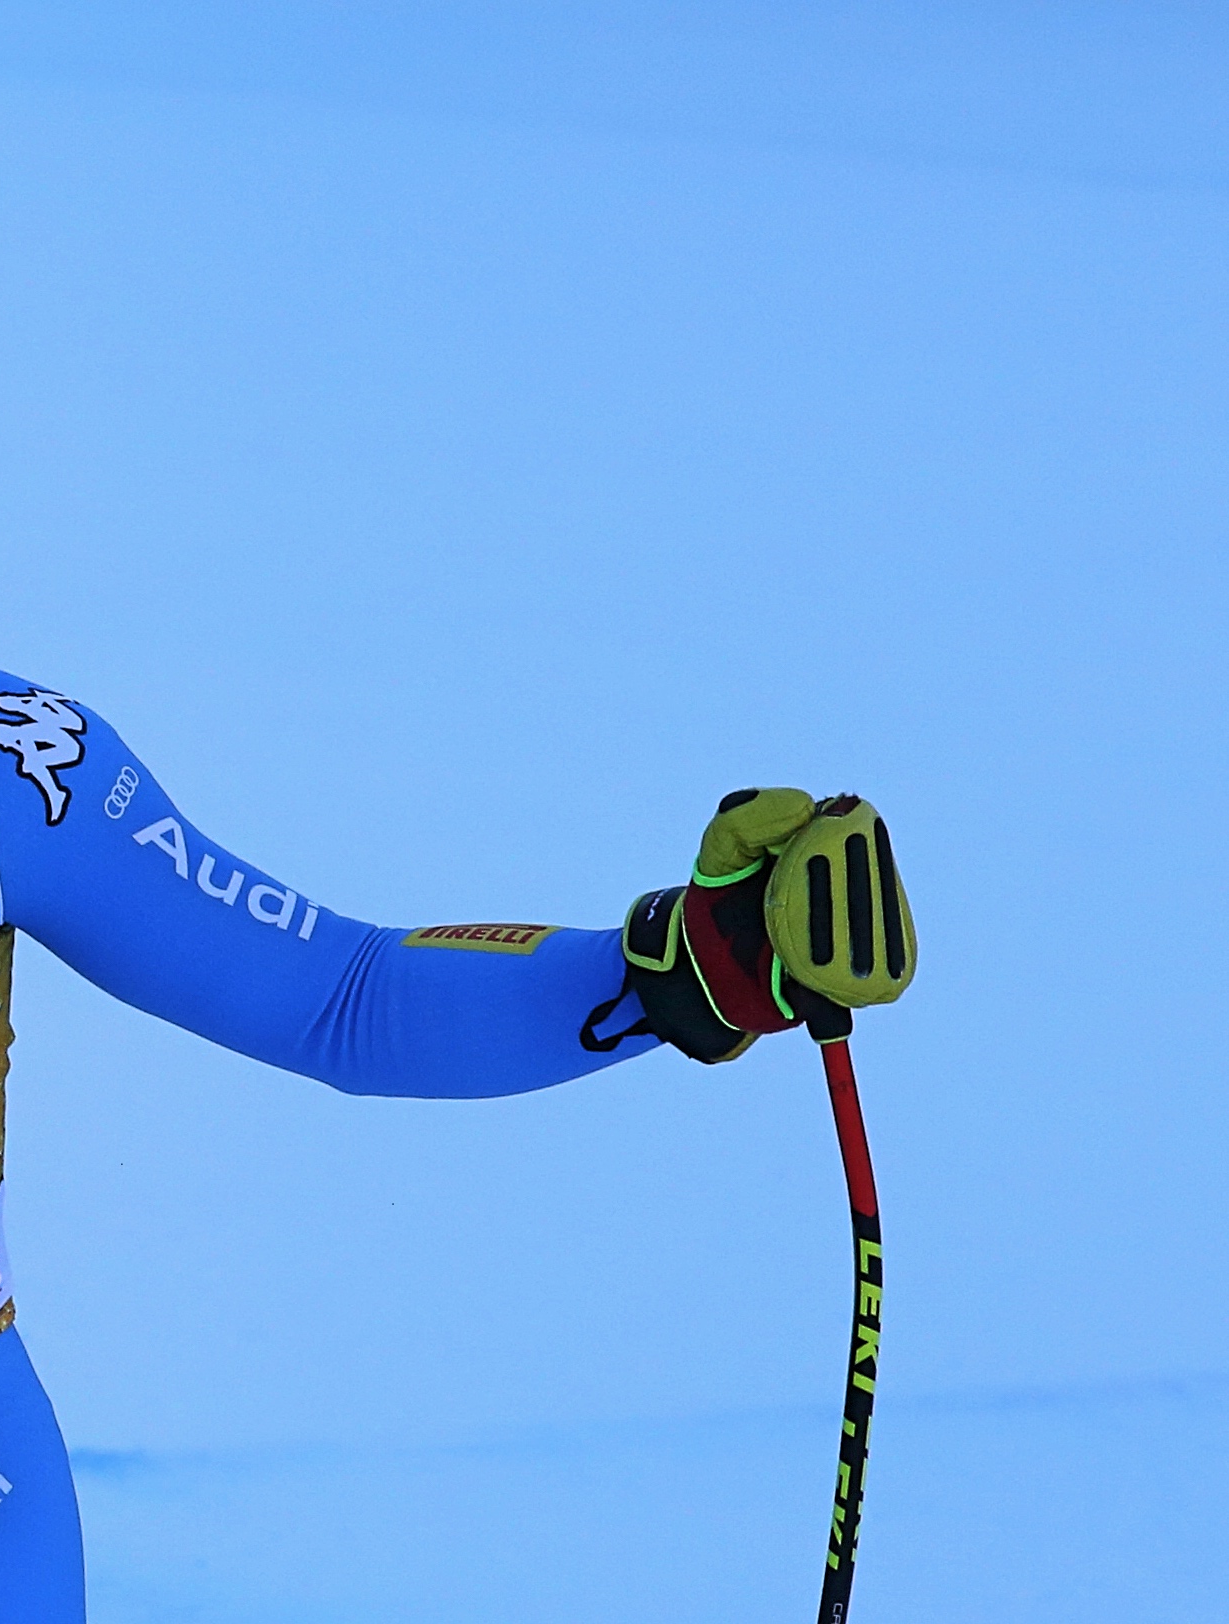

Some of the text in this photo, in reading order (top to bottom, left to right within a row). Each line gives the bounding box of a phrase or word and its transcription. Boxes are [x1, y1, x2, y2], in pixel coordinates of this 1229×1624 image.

[132, 815, 319, 941] Audi
[418, 923, 547, 945] PIRELLI
[852, 1237, 883, 1395] LEKI
